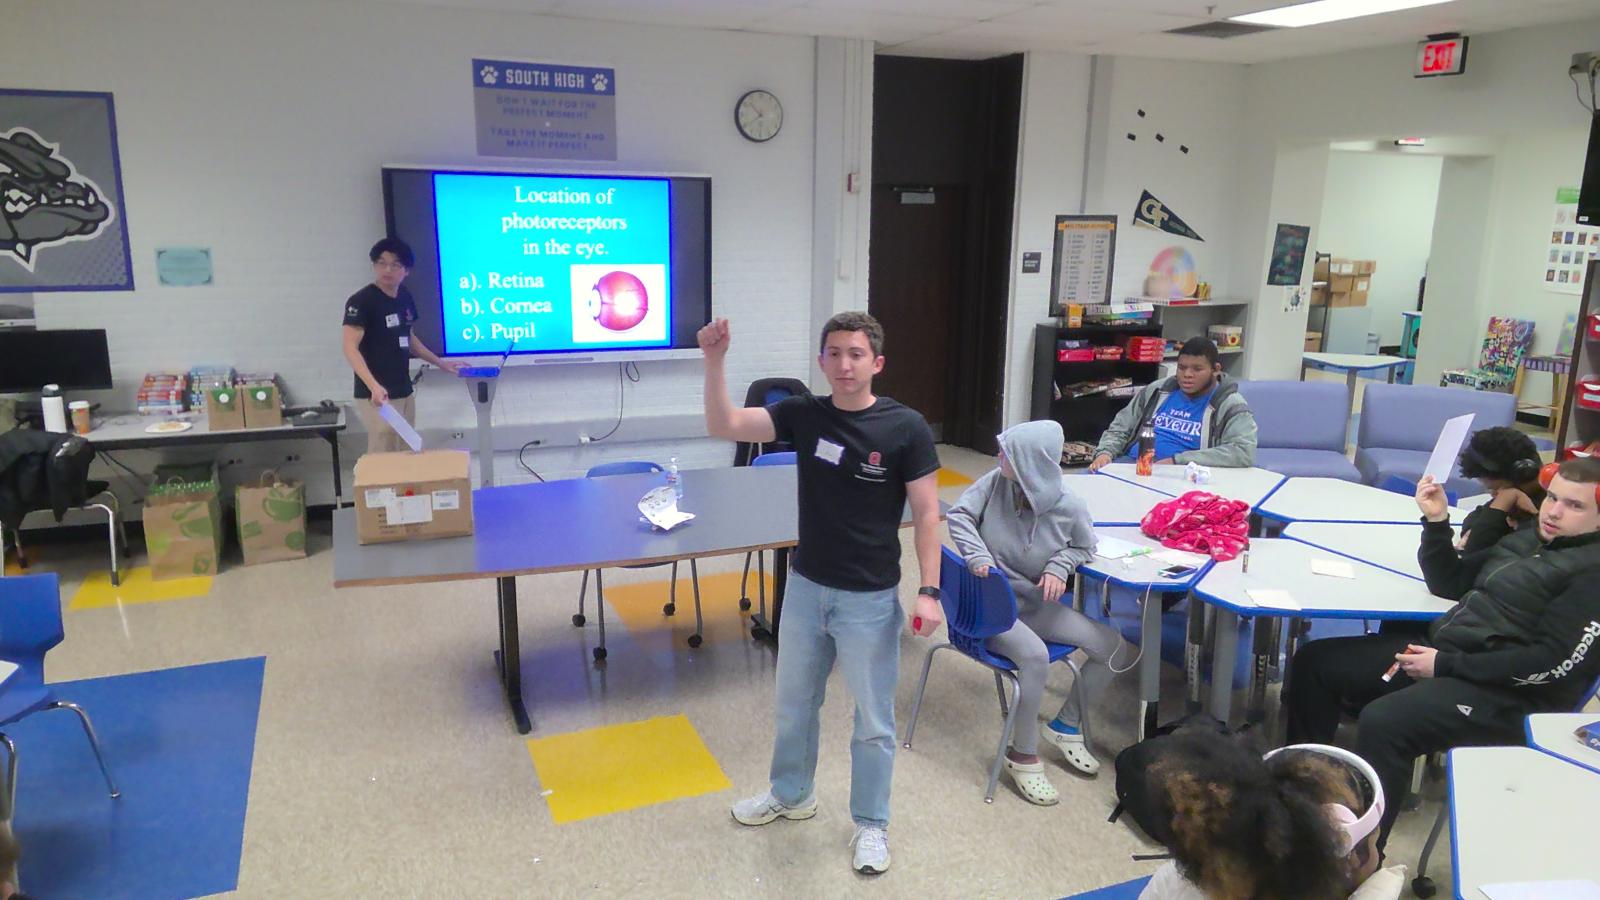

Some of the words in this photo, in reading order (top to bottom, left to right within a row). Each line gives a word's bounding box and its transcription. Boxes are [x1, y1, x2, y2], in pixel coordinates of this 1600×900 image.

[1423, 42, 1456, 72] EXIT
[505, 69, 549, 86] SOUTH
[554, 72, 585, 88] HIGH
[530, 98, 555, 106] WAIT
[558, 99, 577, 108] FOR
[520, 129, 537, 138] THE
[584, 133, 605, 141] AND
[515, 186, 591, 204] Location
[595, 187, 616, 205] of
[501, 212, 628, 234] photoreceptors
[523, 239, 540, 255] in
[544, 238, 572, 255] the
[575, 241, 609, 259] eye.
[459, 273, 482, 292] a).
[488, 271, 545, 289] Retina
[461, 298, 485, 318] b).
[490, 297, 553, 314] Cornea
[462, 324, 485, 343] c).
[491, 321, 536, 342] Pupil
[1170, 409, 1191, 418] TEAM
[1551, 620, 1600, 679] Reebok
